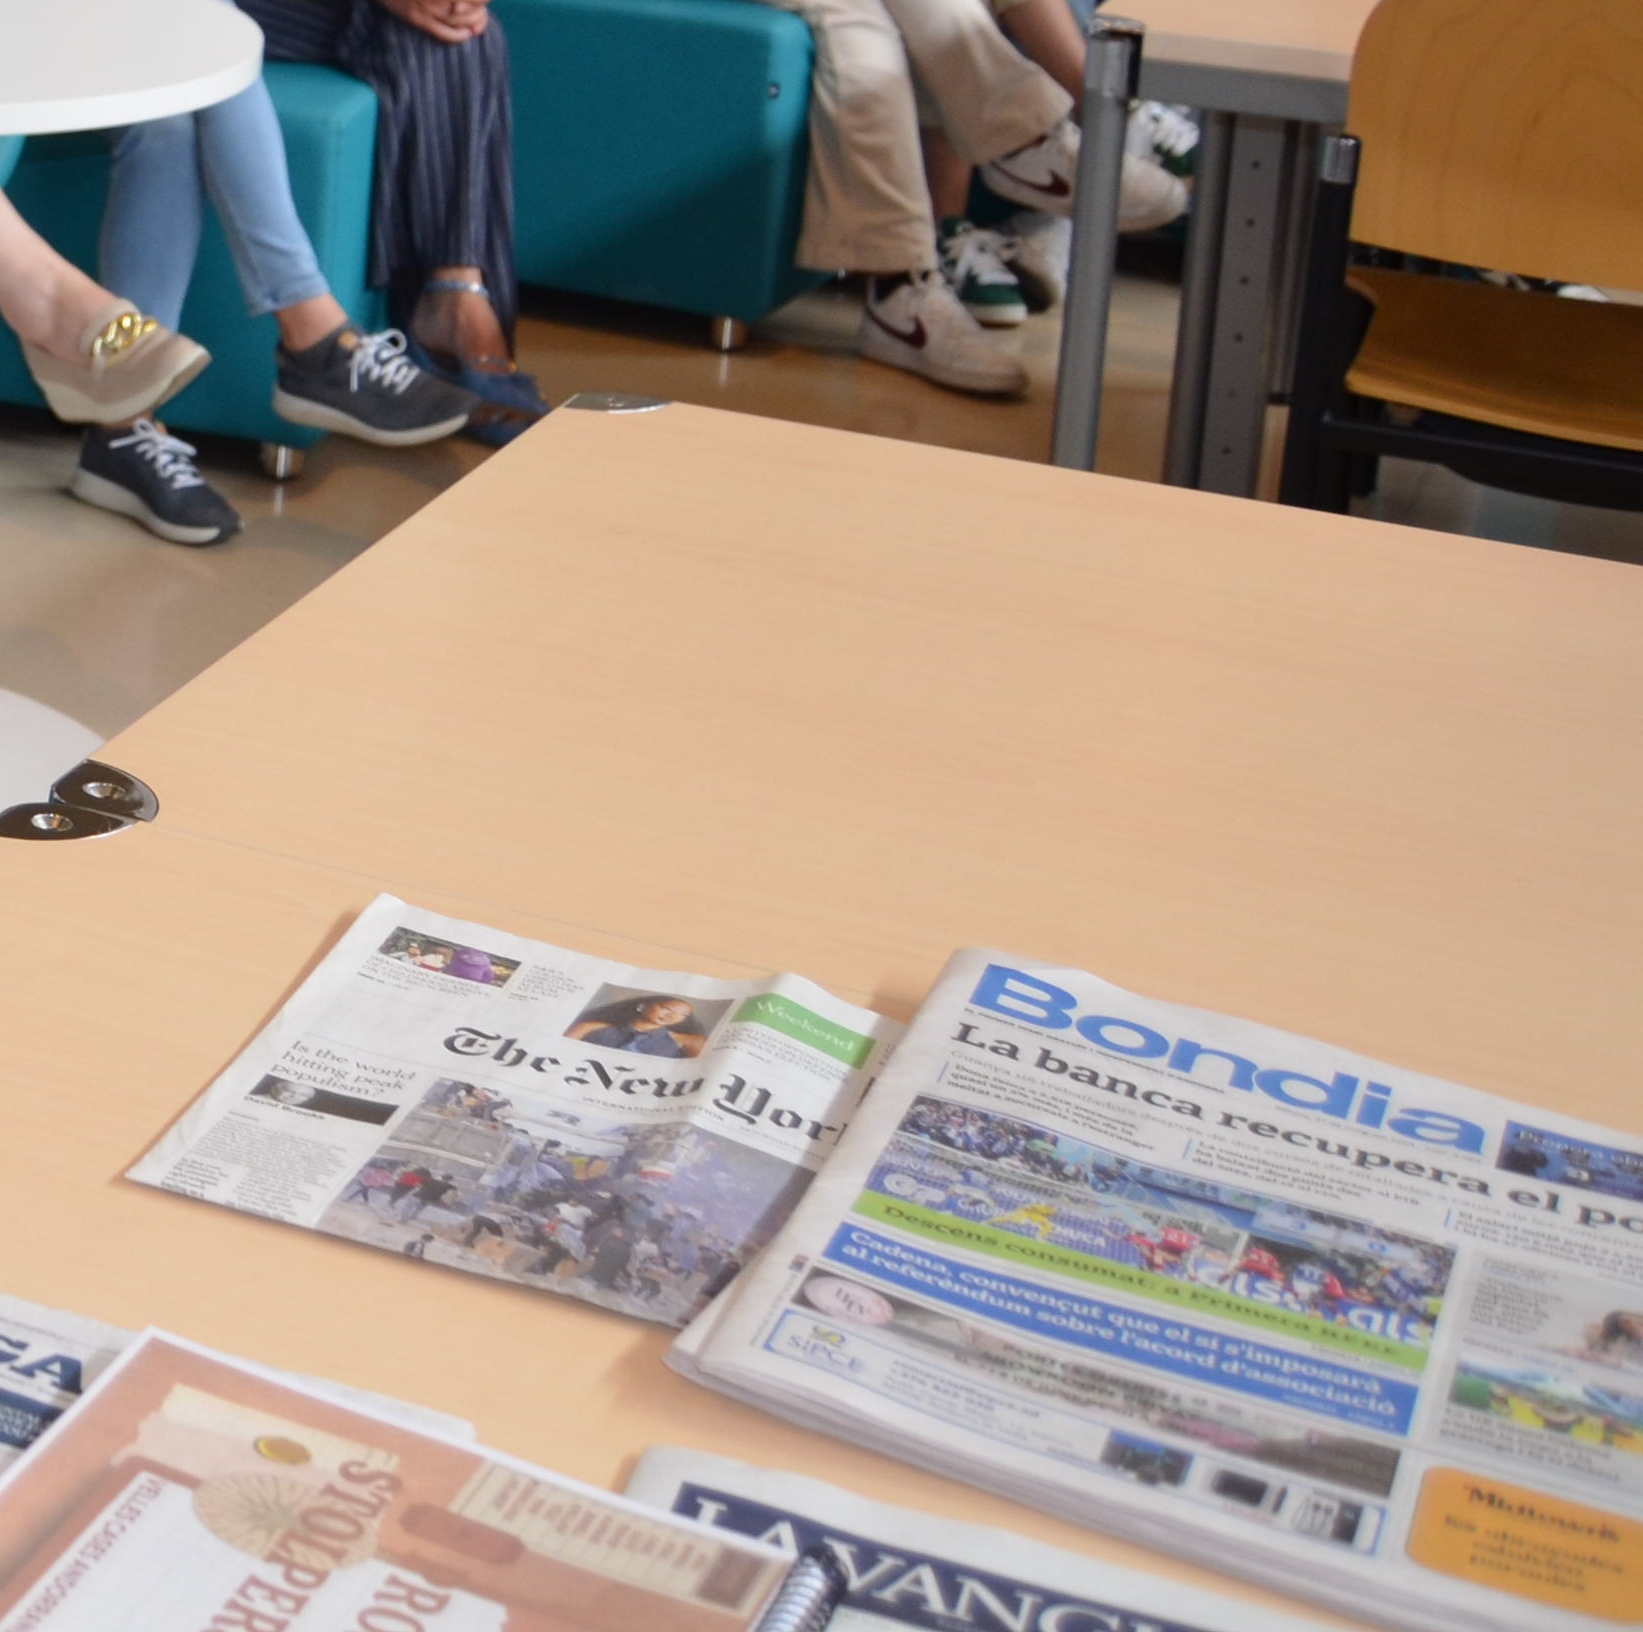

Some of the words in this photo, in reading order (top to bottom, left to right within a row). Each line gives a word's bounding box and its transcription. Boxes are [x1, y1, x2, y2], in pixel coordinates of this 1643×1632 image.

[281, 1049, 350, 1081] hitting
[353, 1070, 405, 1091] peak
[292, 1040, 314, 1054] Is
[315, 1045, 349, 1064] the
[355, 1060, 417, 1083] world
[442, 1025, 562, 1075] The
[563, 1058, 706, 1100] New
[756, 1000, 856, 1051] Weekend
[968, 962, 1487, 1156] Bondia
[269, 1062, 387, 1098] populism?
[950, 1022, 1020, 1062] La
[1033, 1046, 1204, 1122] banca
[1216, 1111, 1492, 1199] recupera
[1506, 1189, 1561, 1215] el
[849, 1227, 952, 1275] Cadena,
[958, 1265, 1104, 1321] convençut
[1107, 1307, 1161, 1336] que
[1165, 1319, 1192, 1342] el
[883, 1204, 999, 1248] Descens
[1003, 1244, 1156, 1292] consumat:
[1163, 1284, 1181, 1298] a
[1188, 1289, 1312, 1334] Primera
[841, 1240, 871, 1262] al
[1034, 1306, 1115, 1343] sobre
[1119, 1321, 1216, 1368] l'acord
[1219, 1357, 1397, 1417] d'associació
[822, 1533, 1165, 1632] VANG
